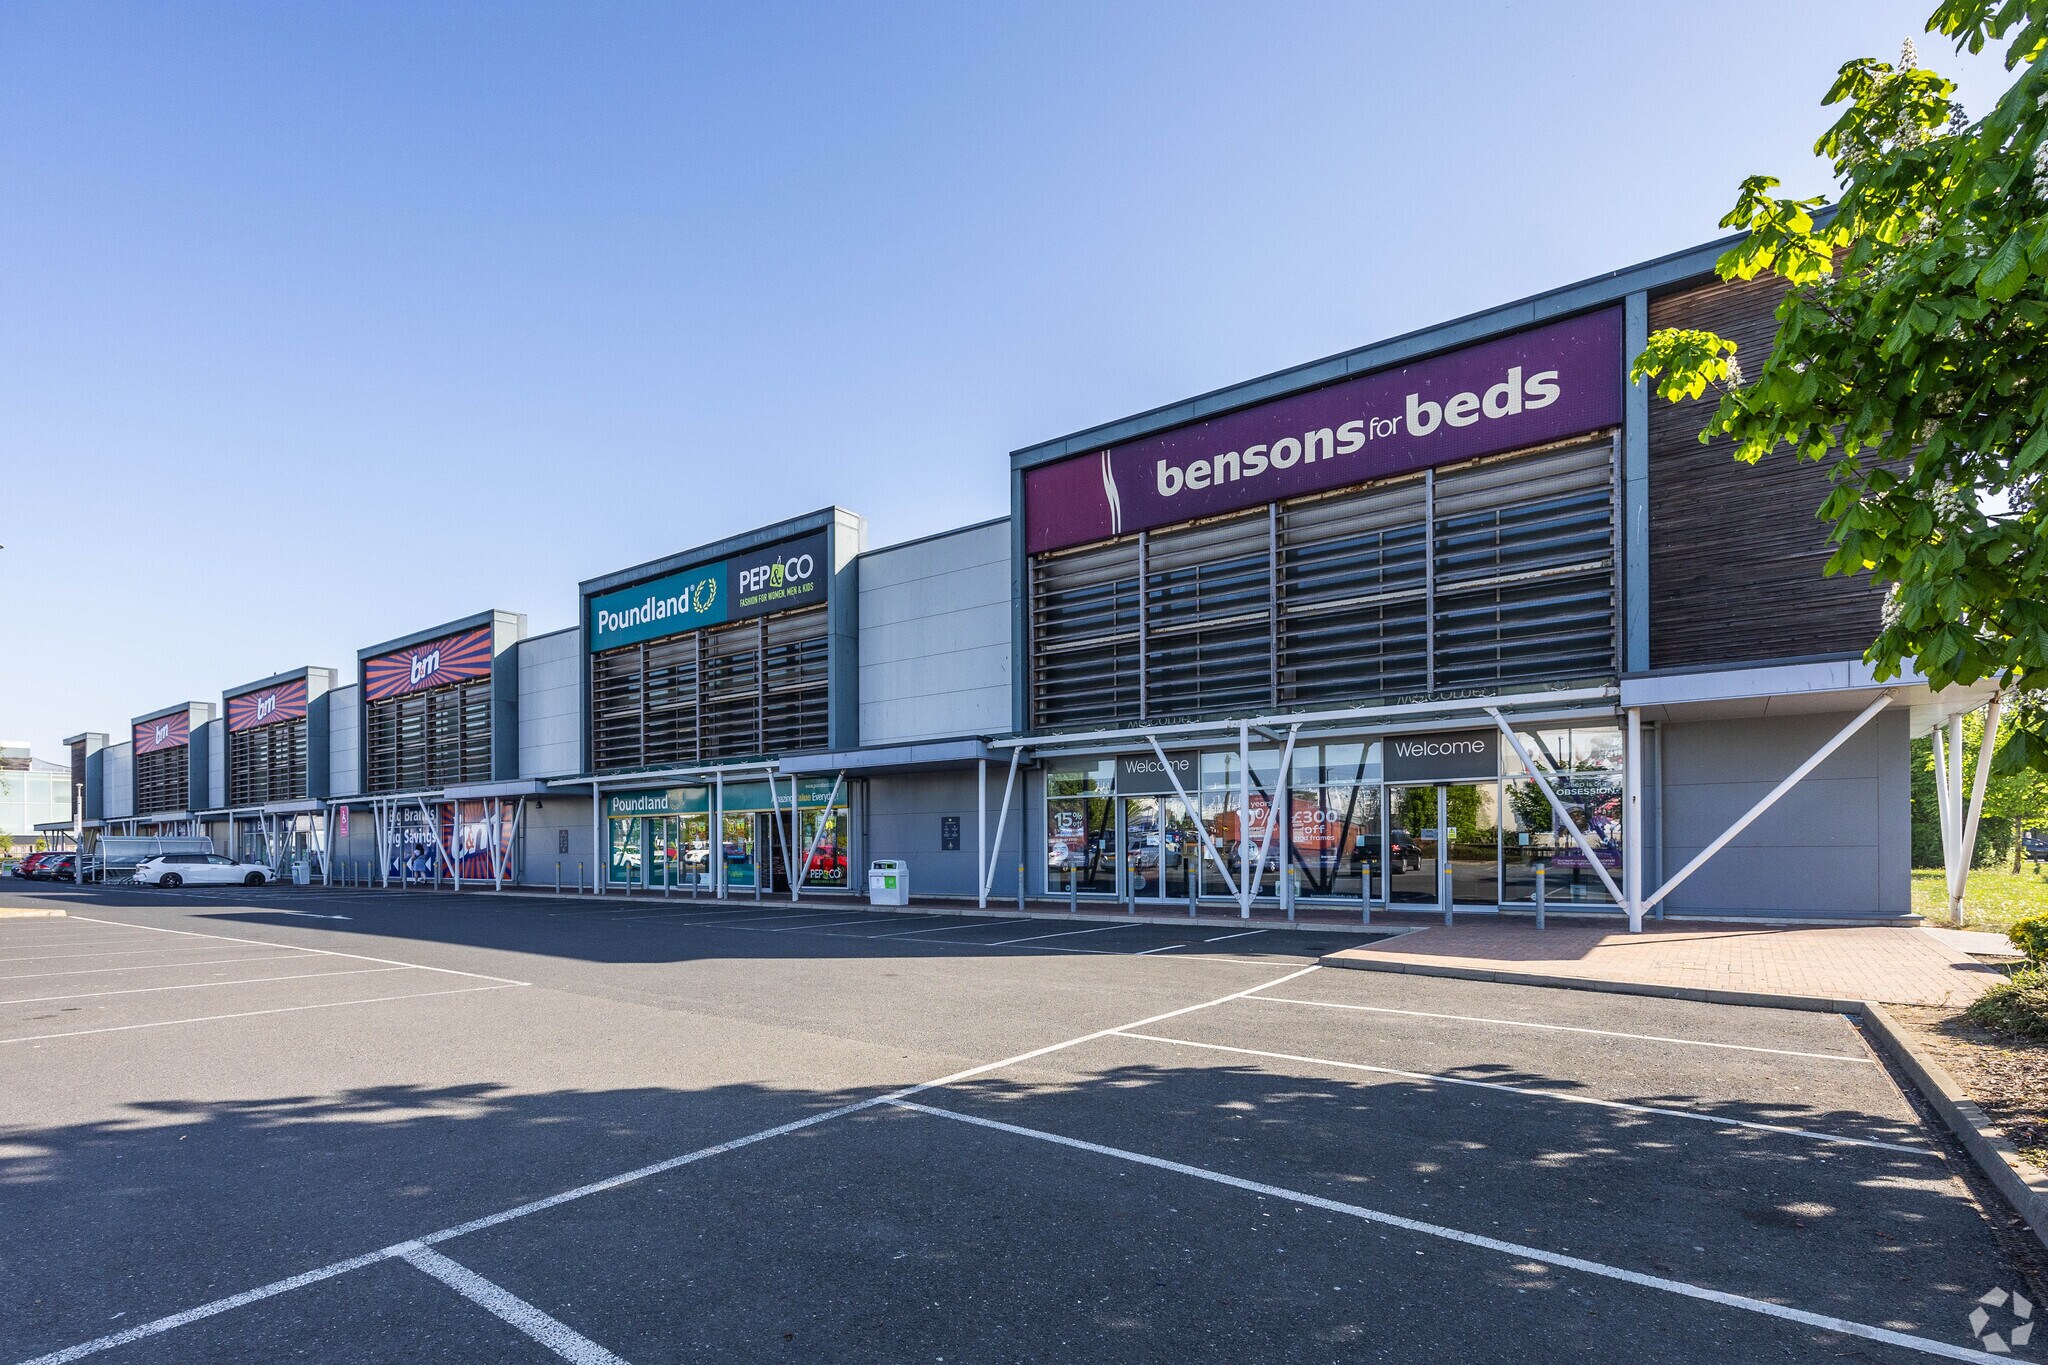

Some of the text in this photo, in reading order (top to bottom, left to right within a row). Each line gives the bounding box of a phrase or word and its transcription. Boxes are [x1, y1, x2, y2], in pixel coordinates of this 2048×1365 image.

[1156, 365, 1561, 498] bensons for beds
[739, 595, 758, 607] FASHION
[758, 593, 768, 603] FOR
[787, 585, 798, 596] MEN
[802, 581, 814, 593] KIDS
[598, 587, 689, 635] Poundland
[1394, 739, 1485, 758] Welcome
[1124, 758, 1190, 774] Welcome
[612, 795, 668, 812] Poundland
[1292, 809, 1338, 824] £300
